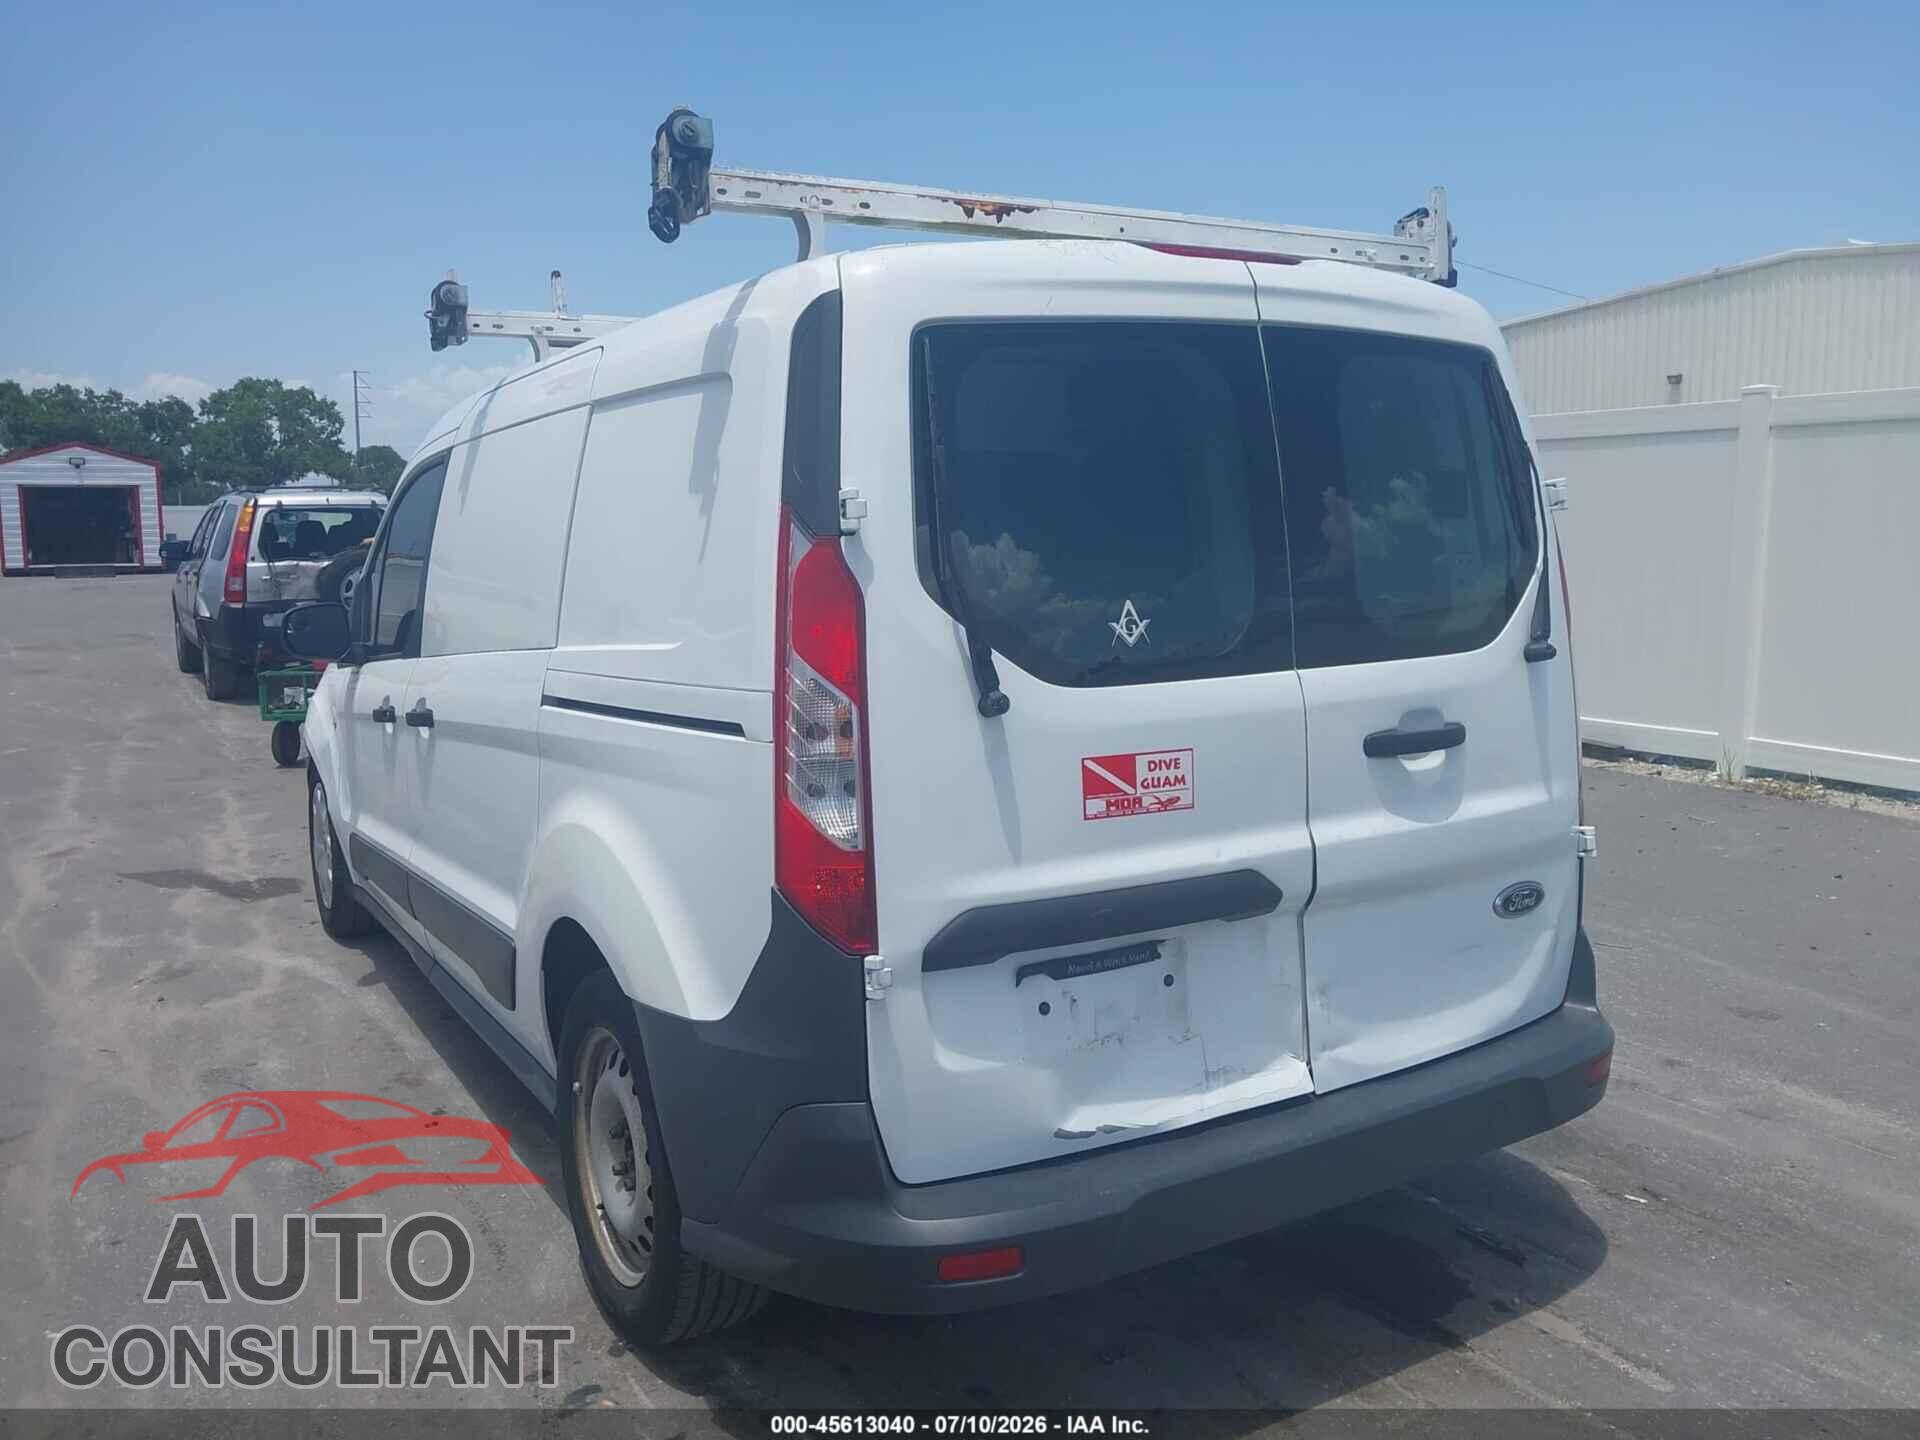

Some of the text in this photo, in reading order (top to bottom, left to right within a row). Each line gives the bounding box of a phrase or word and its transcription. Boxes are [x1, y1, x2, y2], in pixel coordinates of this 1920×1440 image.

[1123, 616, 1137, 634] G
[1147, 757, 1182, 773] DIVE
[1140, 774, 1187, 790] GUAM
[1508, 889, 1538, 912] Ford
